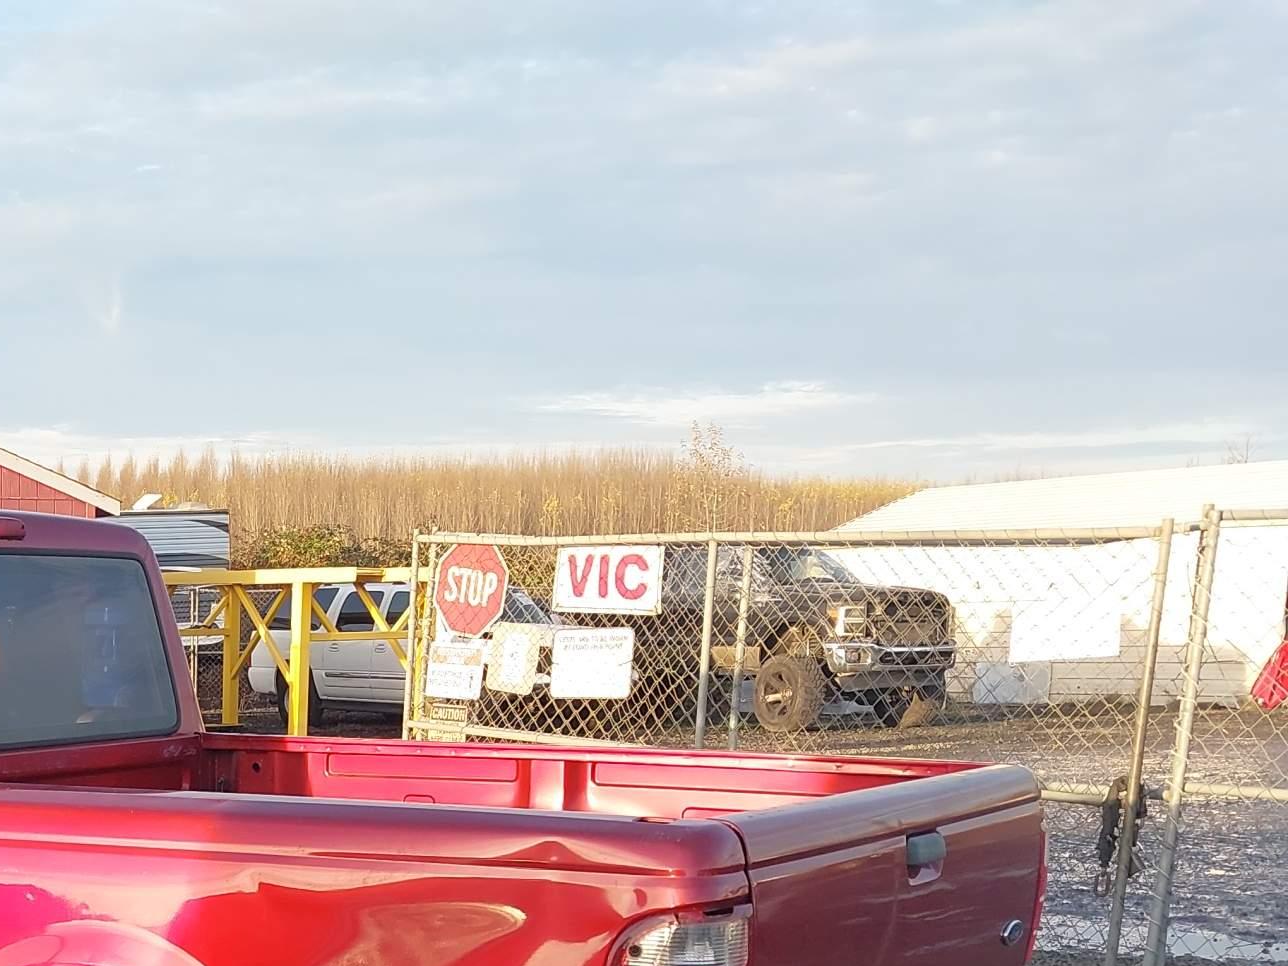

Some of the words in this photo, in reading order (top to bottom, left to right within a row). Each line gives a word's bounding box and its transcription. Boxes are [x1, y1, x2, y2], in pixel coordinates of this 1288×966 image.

[444, 566, 498, 607] STOP
[568, 554, 649, 600] VIC
[431, 707, 465, 721] CAUTION
